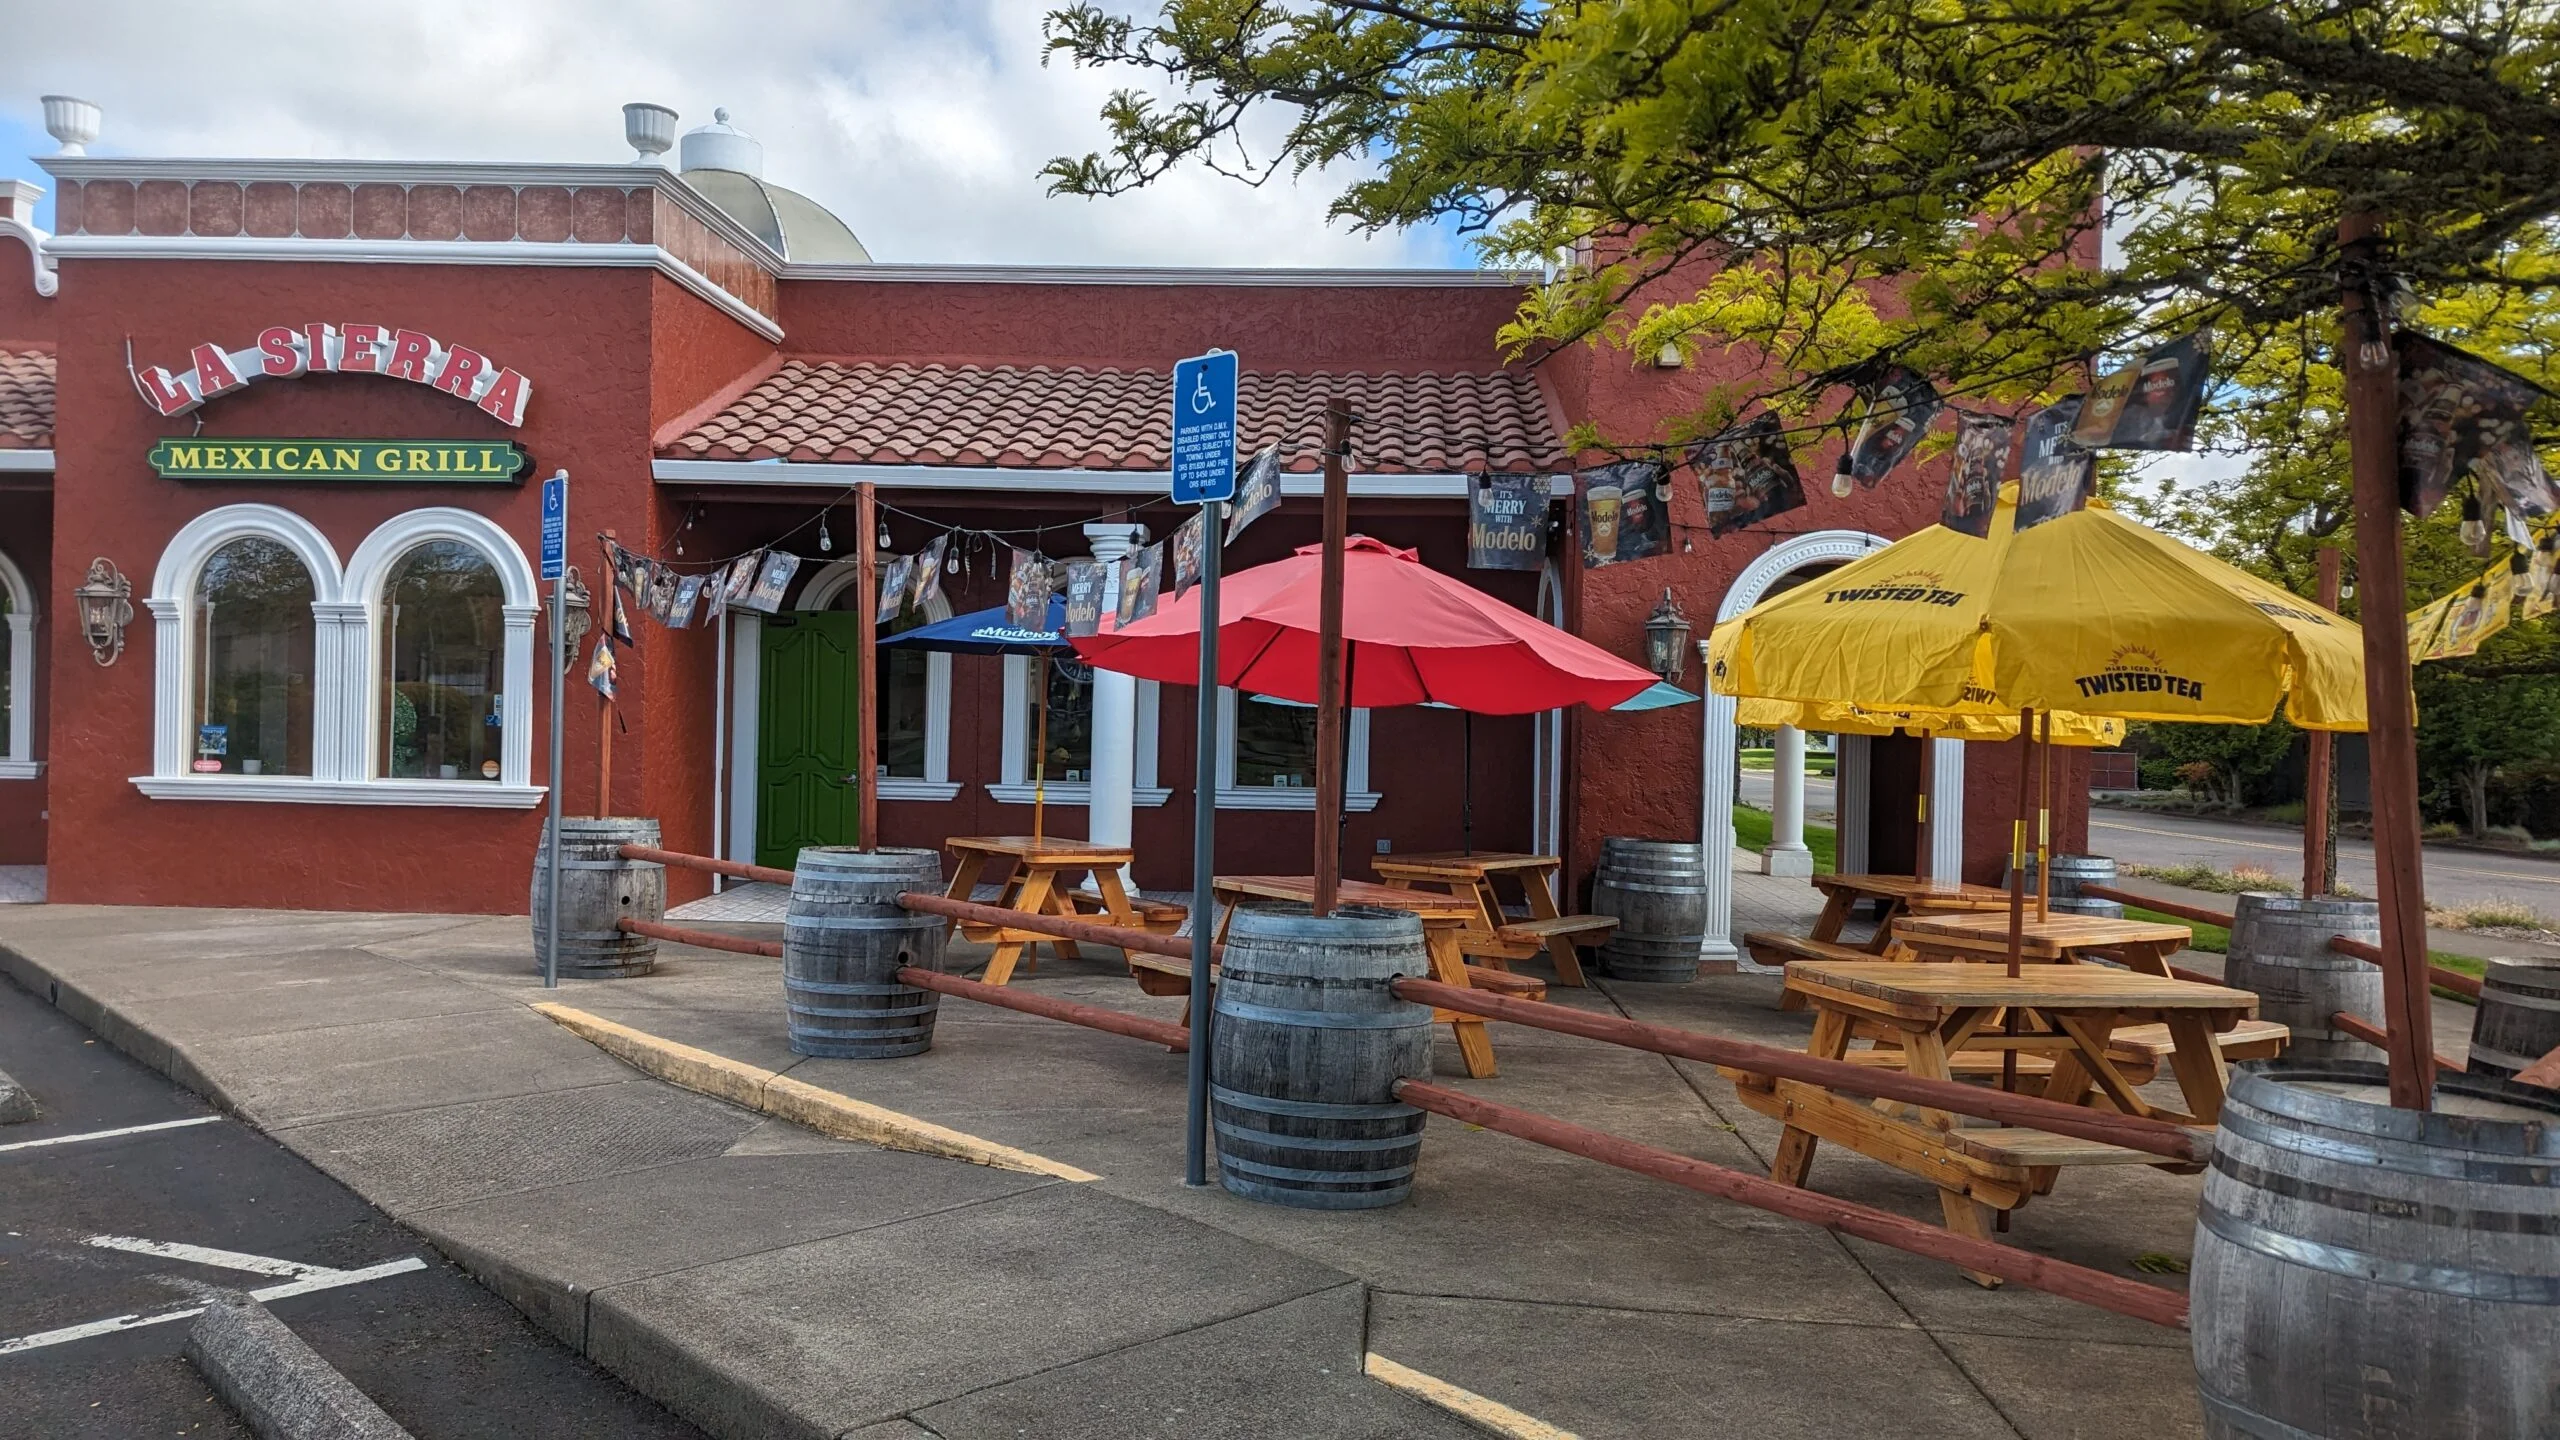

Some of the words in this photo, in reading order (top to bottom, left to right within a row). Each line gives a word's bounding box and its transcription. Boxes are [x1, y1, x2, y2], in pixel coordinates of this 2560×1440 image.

[138, 343, 246, 417] LA
[258, 323, 530, 427] SIERRA
[2143, 378, 2175, 392] Modelo
[1180, 426, 1200, 435] PARKING
[1201, 424, 1213, 432] WITH
[1177, 435, 1199, 445] DISABLED
[1200, 432, 1217, 441] PERMIT
[1218, 431, 1231, 439] ONLY
[1176, 444, 1201, 453] VIOLATORS
[1202, 440, 1223, 451] SUBJECT
[1224, 439, 1231, 447] TO
[168, 447, 361, 471] MEXICAN
[375, 449, 502, 473] GRILL
[1186, 452, 1204, 461] TOWING
[1205, 450, 1221, 459] UNDER
[1206, 460, 1216, 468] AND
[1218, 458, 1229, 466] FINE
[1181, 472, 1187, 480] UP
[1188, 471, 1194, 479] TO
[1209, 468, 1225, 476] UNDER
[2021, 461, 2082, 507] Modelo
[1499, 490, 1513, 499] IT'S
[1484, 500, 1527, 515] MERRY
[1626, 503, 1648, 517] Modelo
[1495, 515, 1513, 523] WITH
[1591, 510, 1619, 523] Modelo
[1472, 522, 1537, 551] Modelo
[1071, 582, 1093, 595] MERRY
[1823, 588, 1928, 604] TWISTED
[1922, 589, 1967, 608] TEA
[2130, 665, 2150, 673] ICED
[2075, 672, 2162, 698] TWISTED
[2164, 675, 2203, 702] TEA
